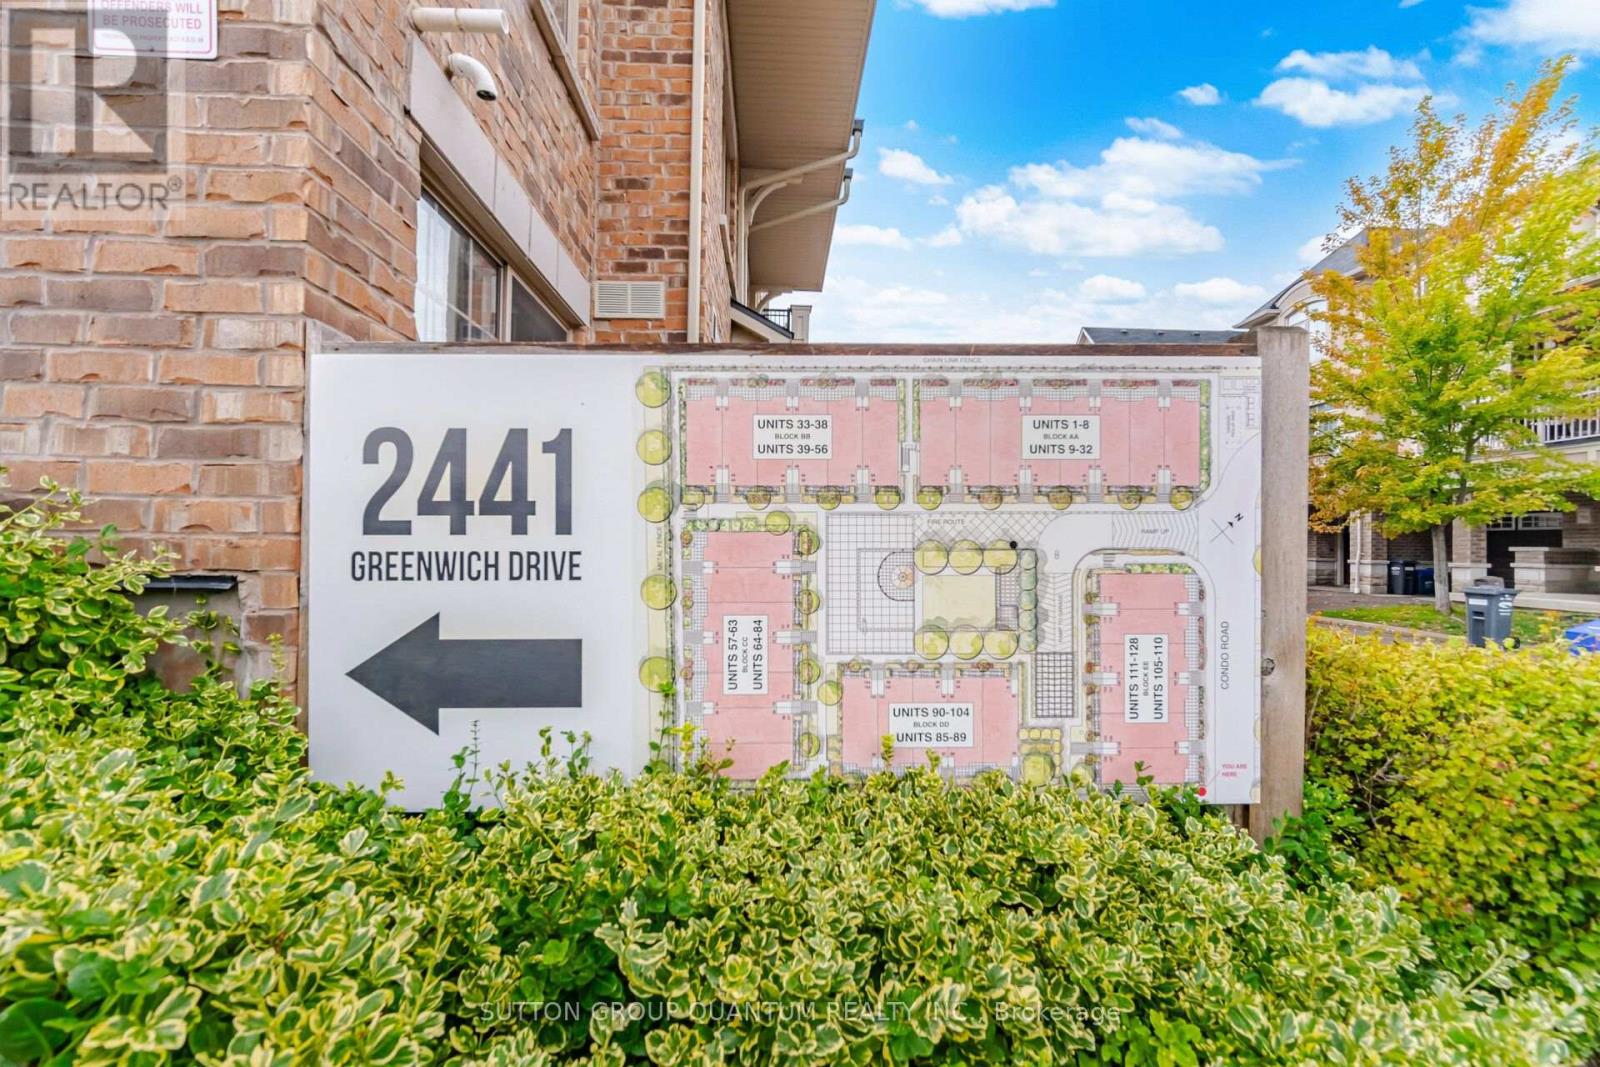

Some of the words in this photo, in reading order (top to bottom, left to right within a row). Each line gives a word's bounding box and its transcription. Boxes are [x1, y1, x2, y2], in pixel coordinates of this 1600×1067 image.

[102, 0, 172, 12] OFFENDERS
[175, 3, 203, 14] WILL
[103, 14, 119, 26] BE
[122, 16, 202, 29] PROSECUTED
[757, 419, 794, 430] UNITS
[797, 419, 828, 430] 33-38
[1033, 419, 1069, 430] UNITS
[1073, 419, 1090, 430] 1-8
[757, 444, 794, 454] UNITS
[797, 444, 828, 454] 39-56
[1029, 444, 1066, 454] UNITS
[1068, 444, 1093, 454] 9-32
[362, 426, 573, 536] 2441
[943, 518, 966, 526] ROUTE
[351, 551, 499, 581] GREENWICH
[509, 551, 582, 581] DRIVE
[728, 619, 738, 651] 57-63
[753, 619, 763, 651] 64-84
[1220, 621, 1229, 650] ROAD
[728, 654, 738, 690] UNITS
[753, 654, 763, 690] UNITS
[1129, 637, 1139, 679] 111-128
[1154, 637, 1163, 679] 105-110
[1220, 652, 1229, 690] CONDO
[893, 707, 929, 717] UNITS
[932, 707, 970, 717] 90-104
[1129, 683, 1139, 720] UNITS
[1154, 683, 1163, 720] UNITS
[896, 732, 932, 742] UNITS
[935, 732, 967, 742] 85-89
